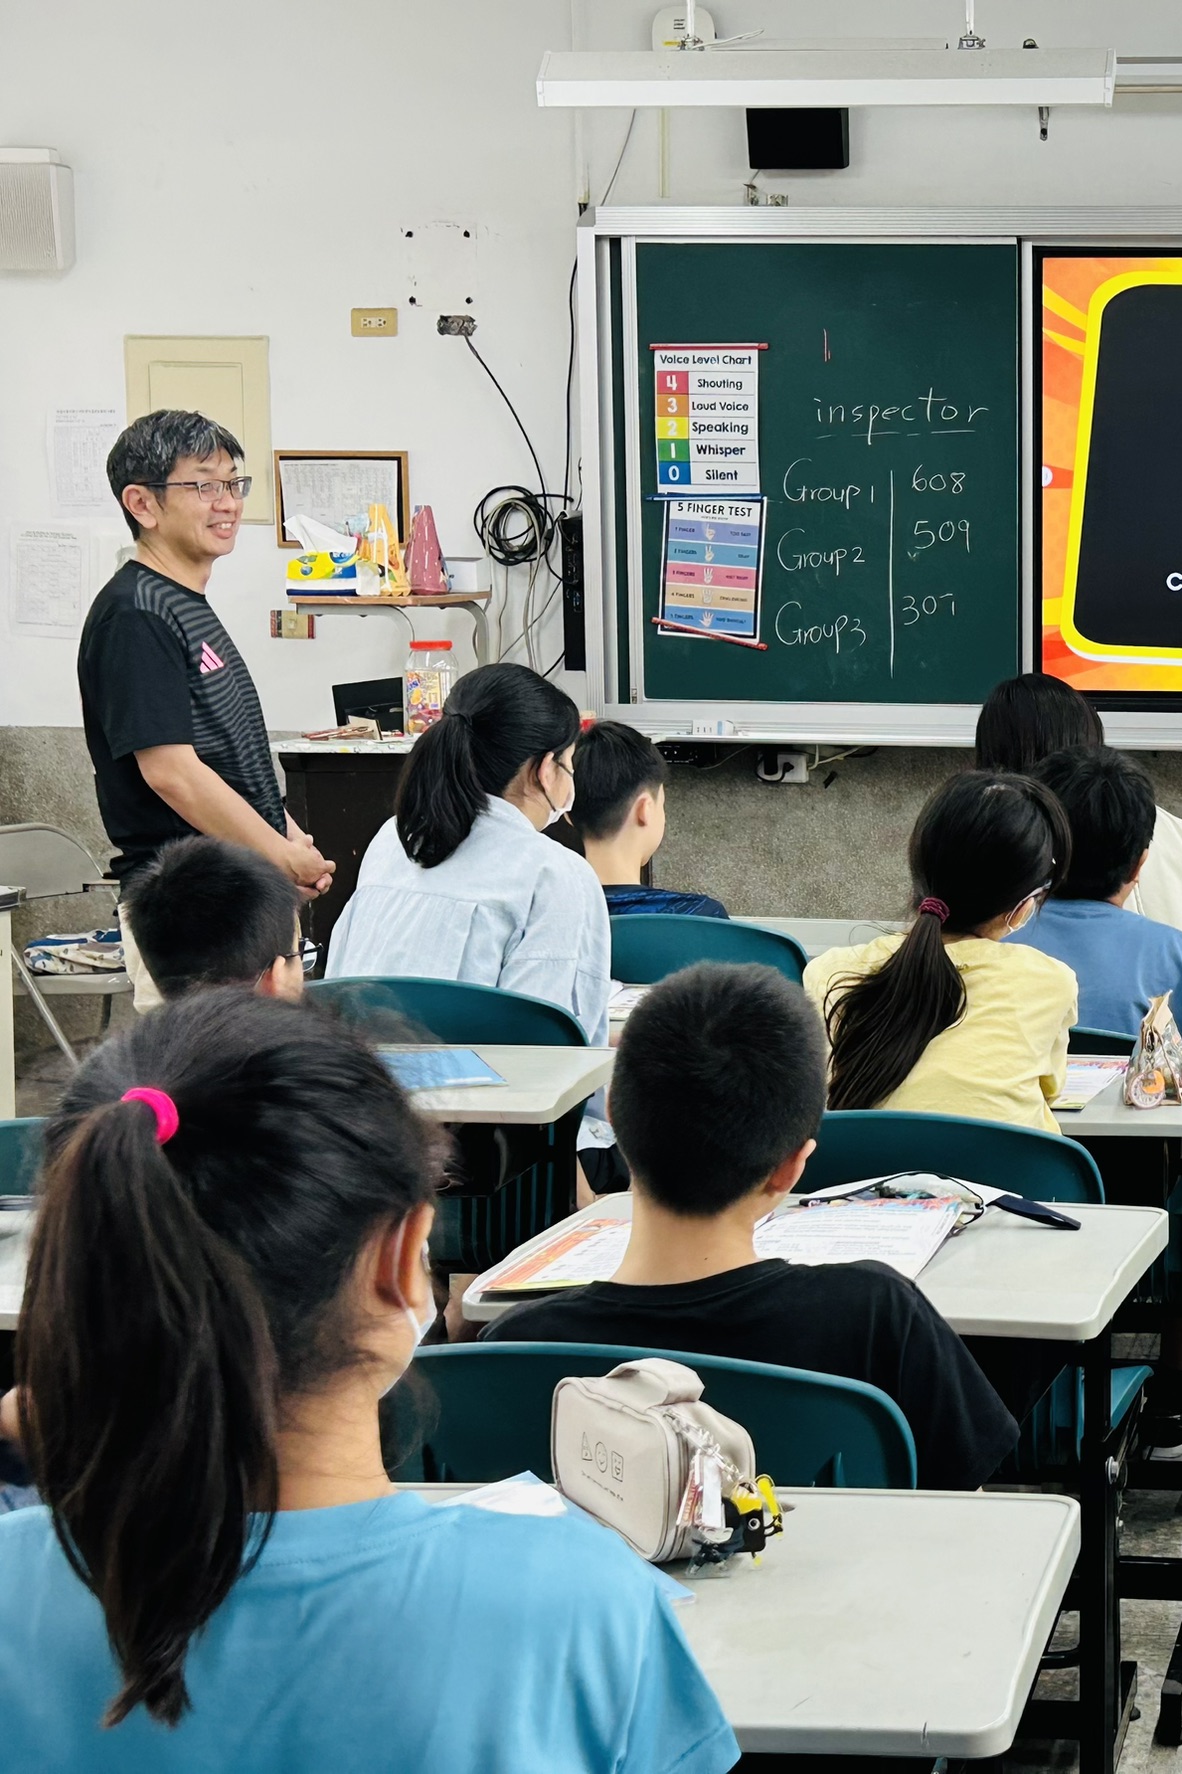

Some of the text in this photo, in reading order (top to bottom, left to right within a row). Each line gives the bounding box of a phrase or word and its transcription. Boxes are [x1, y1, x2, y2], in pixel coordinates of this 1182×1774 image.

[660, 354, 752, 365] Voice Level Chart
[666, 375, 743, 391] 4 Shouting
[667, 397, 749, 413] 3 Loud Voice
[813, 387, 990, 445] inspector
[667, 420, 749, 437] 2 Speaking
[671, 442, 746, 459] 1 Whisper
[668, 465, 739, 481] 0 Silent
[911, 464, 966, 494] 608
[783, 457, 861, 510] Group
[677, 502, 753, 517] 5 FINGER TEST
[913, 519, 970, 553] 509
[777, 528, 866, 576] Group 2
[775, 601, 867, 654] Group 3
